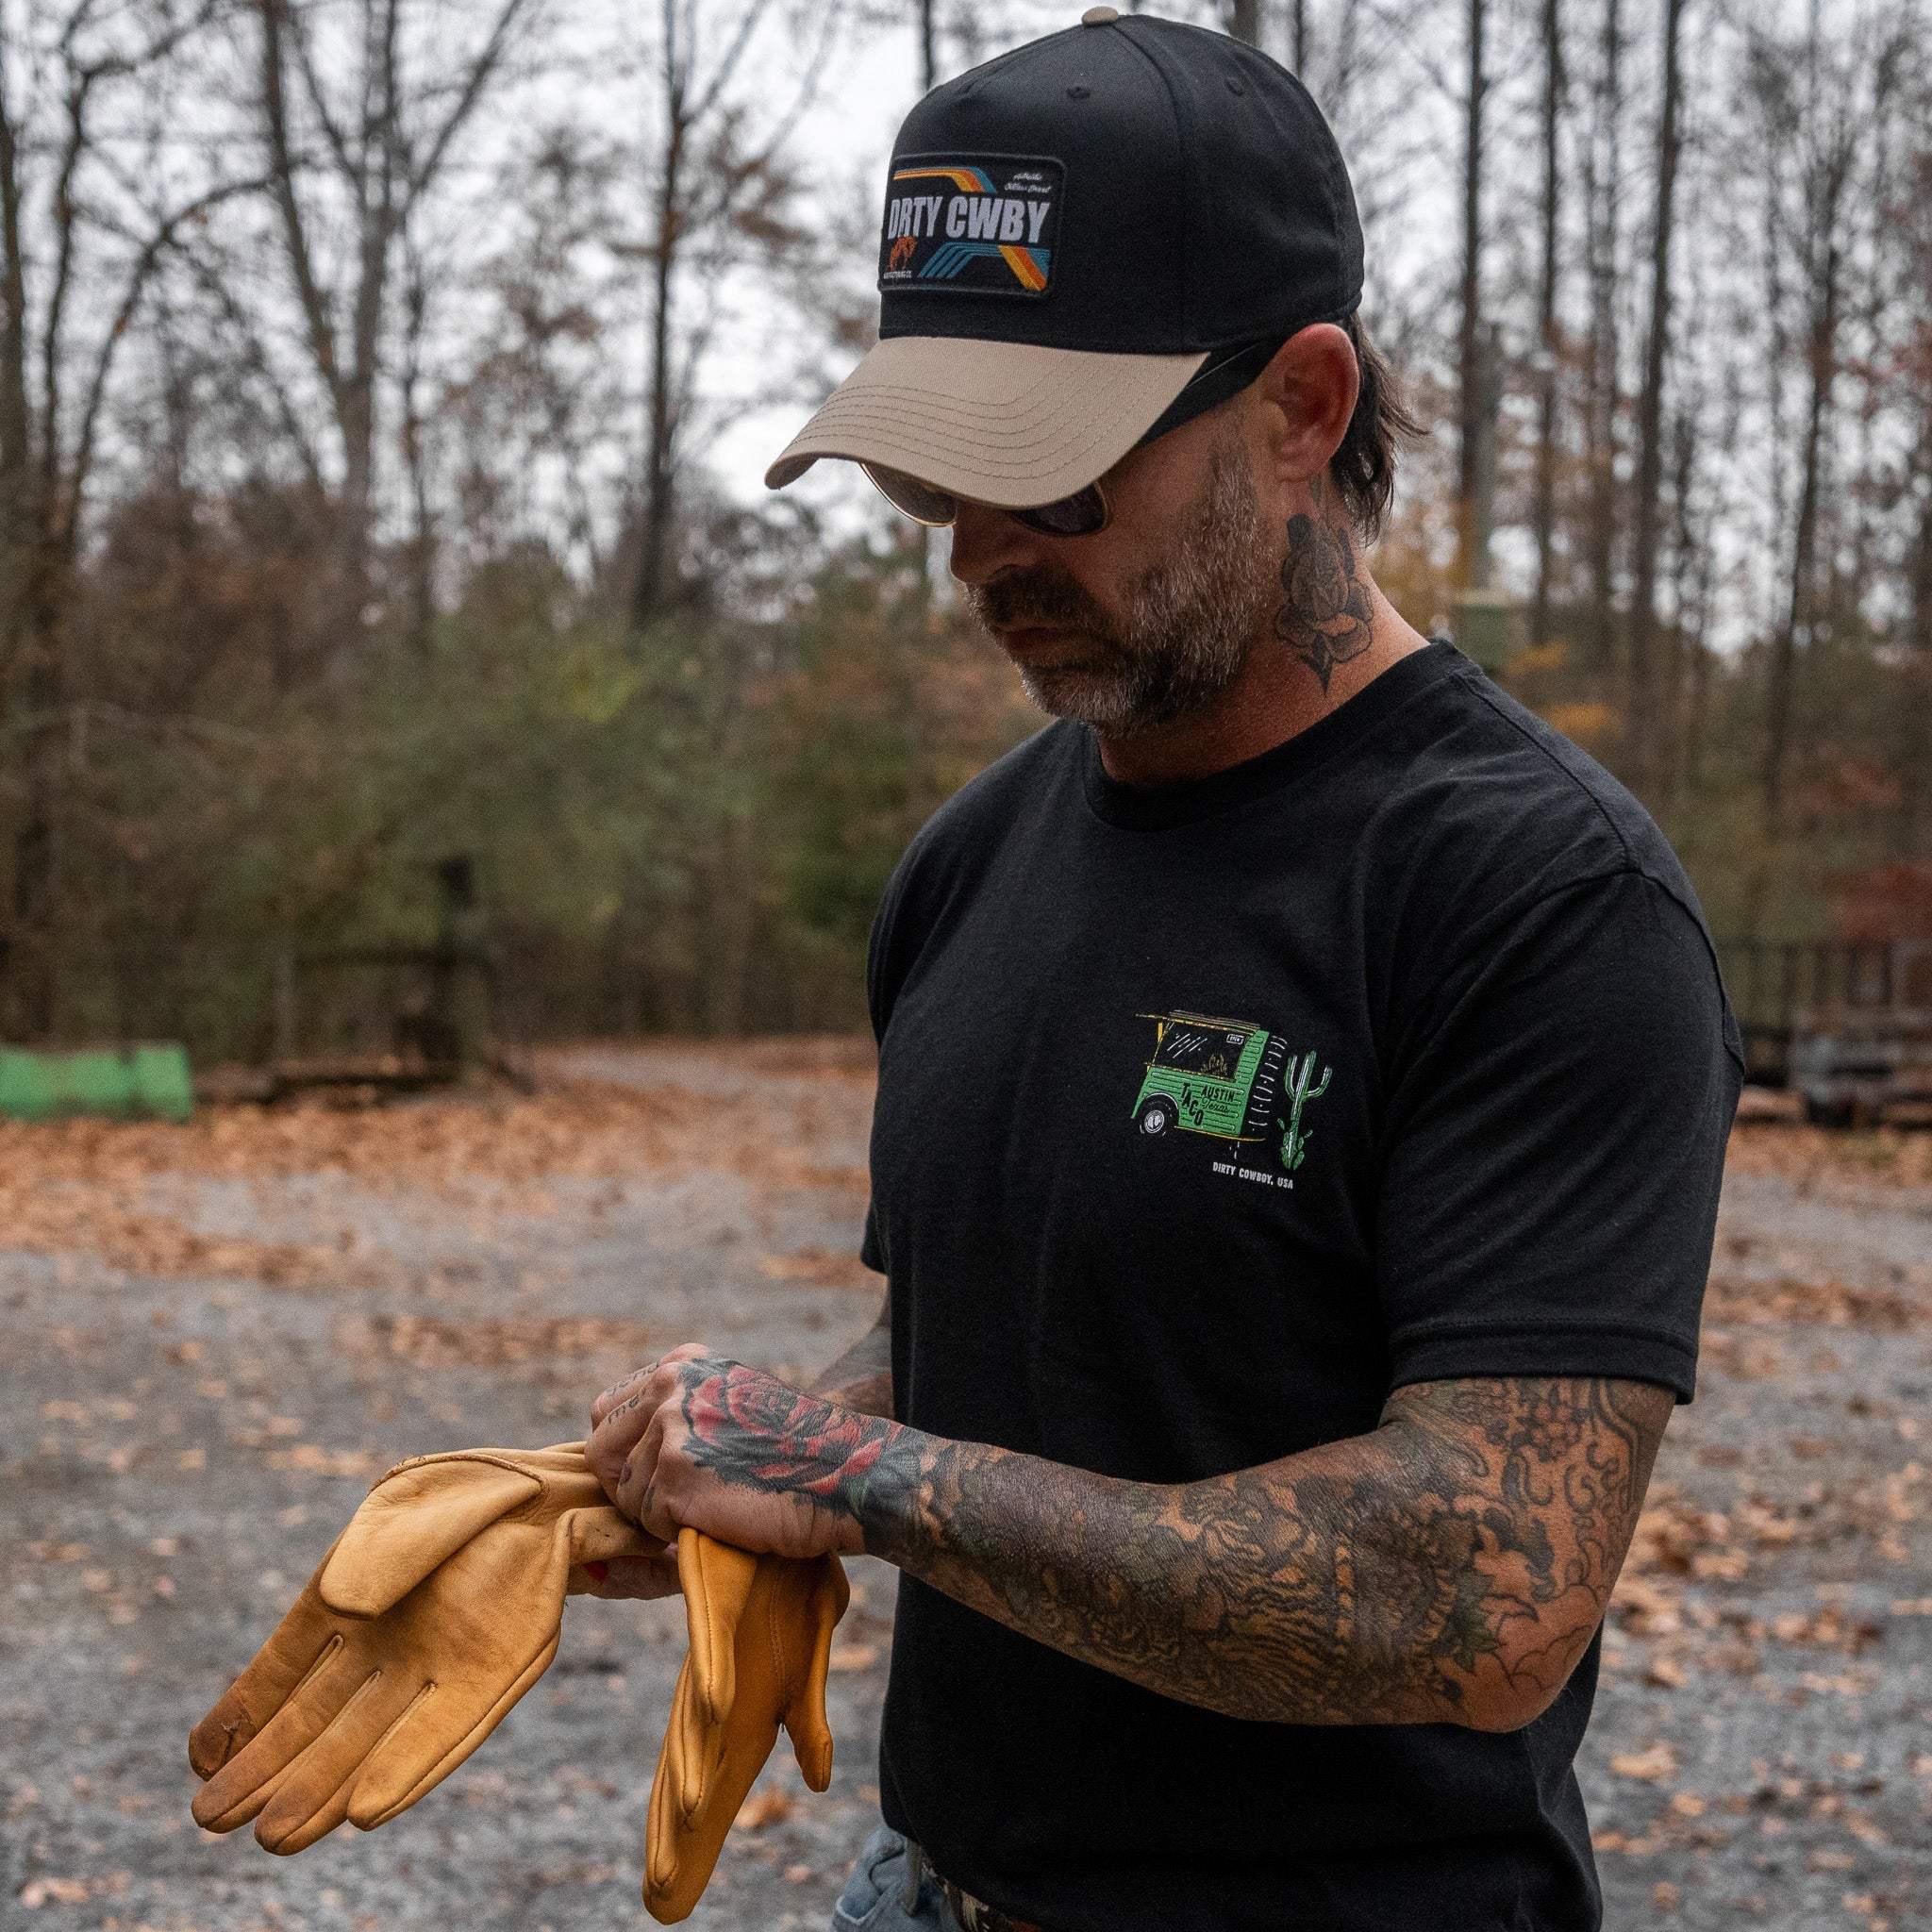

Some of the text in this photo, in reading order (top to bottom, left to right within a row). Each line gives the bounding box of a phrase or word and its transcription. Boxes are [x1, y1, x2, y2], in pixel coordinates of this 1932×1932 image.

[888, 196, 1051, 243] DRTY CWBY
[1181, 1082, 1204, 1125] TACO
[1201, 1085, 1235, 1102] AUSTIN
[1202, 1097, 1229, 1113] Texas
[1212, 1161, 1237, 1175] DIRTY
[1276, 1176, 1293, 1190] USA
